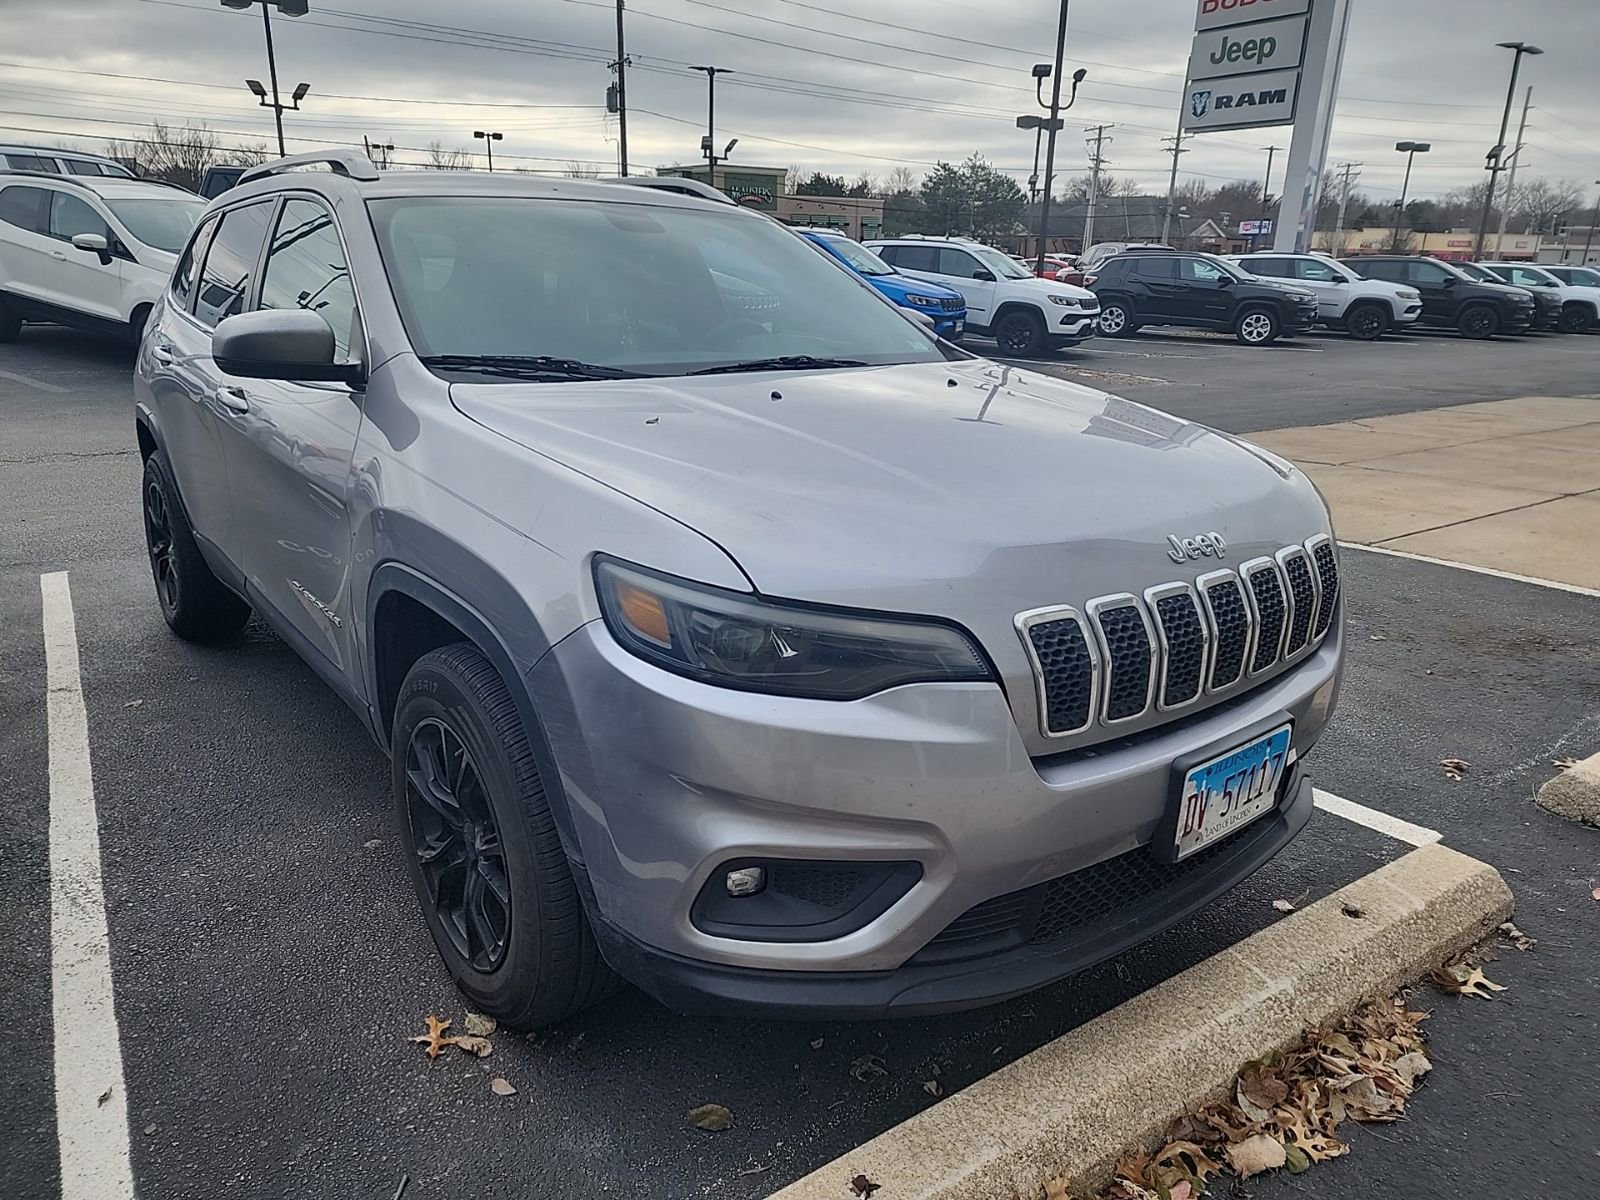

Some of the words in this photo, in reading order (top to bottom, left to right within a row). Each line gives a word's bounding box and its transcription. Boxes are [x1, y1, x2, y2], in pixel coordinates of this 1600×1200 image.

[1210, 36, 1276, 64] Jeep
[1214, 89, 1286, 109] RAM
[1166, 532, 1227, 564] Jeep
[1220, 751, 1283, 817] 57117
